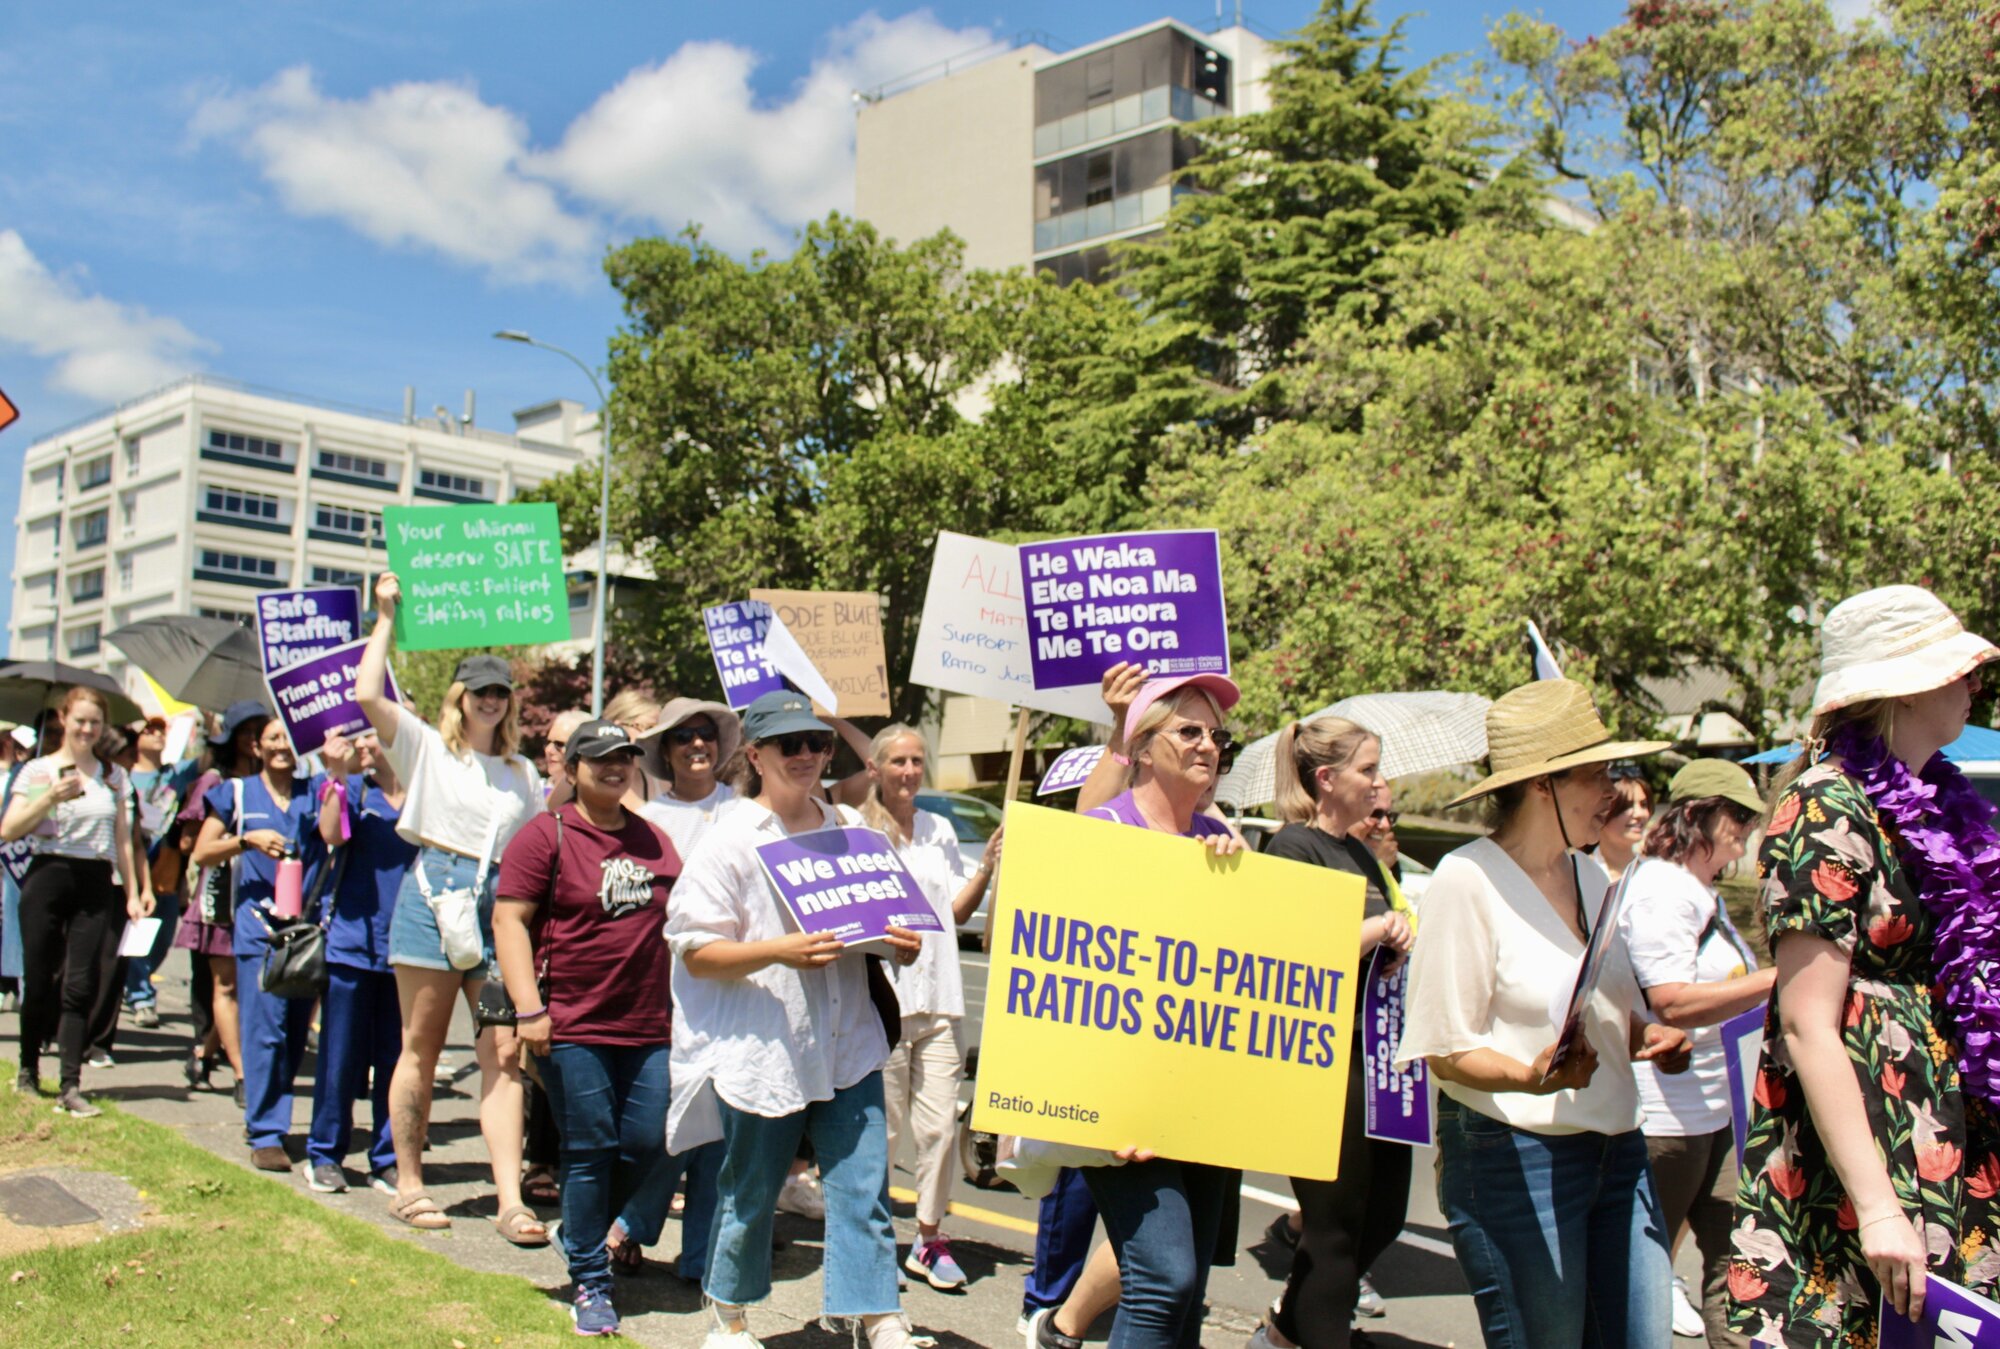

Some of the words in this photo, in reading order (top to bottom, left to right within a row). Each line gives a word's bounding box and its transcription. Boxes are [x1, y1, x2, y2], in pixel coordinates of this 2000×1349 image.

[494, 540, 555, 569] SAFE
[1028, 553, 1068, 577] He
[1072, 543, 1156, 572] Waka
[962, 554, 1023, 601] ALL
[1031, 578, 1083, 605] Eke
[1088, 573, 1148, 598] Noa
[1152, 569, 1197, 593] Ma
[262, 593, 318, 620] Safe
[706, 606, 739, 628] He
[776, 604, 827, 629] ODE
[1033, 608, 1069, 632] Te
[1072, 601, 1178, 628] Hauora
[265, 615, 353, 643] Staffing
[711, 624, 753, 648] Eke
[942, 623, 1020, 651] SUPPORT
[1037, 635, 1082, 660] Me
[1086, 630, 1122, 654] Te
[1127, 626, 1179, 651] Ora
[717, 648, 746, 668] Te
[278, 679, 320, 706] Time
[320, 671, 342, 689] to
[723, 665, 760, 688] Me
[289, 690, 343, 723] health
[776, 857, 836, 887] We
[836, 849, 904, 876] need
[796, 874, 908, 916] nurses!
[1010, 908, 1345, 1014] NURSE-TO-PATIENT
[1006, 966, 1144, 1036] RATIOS
[1153, 993, 1240, 1053] SAVE
[1247, 1010, 1336, 1070] LIVES
[1377, 1039, 1389, 1090] Ora
[988, 1091, 1035, 1115] Ratio
[1037, 1099, 1101, 1124] Justice
